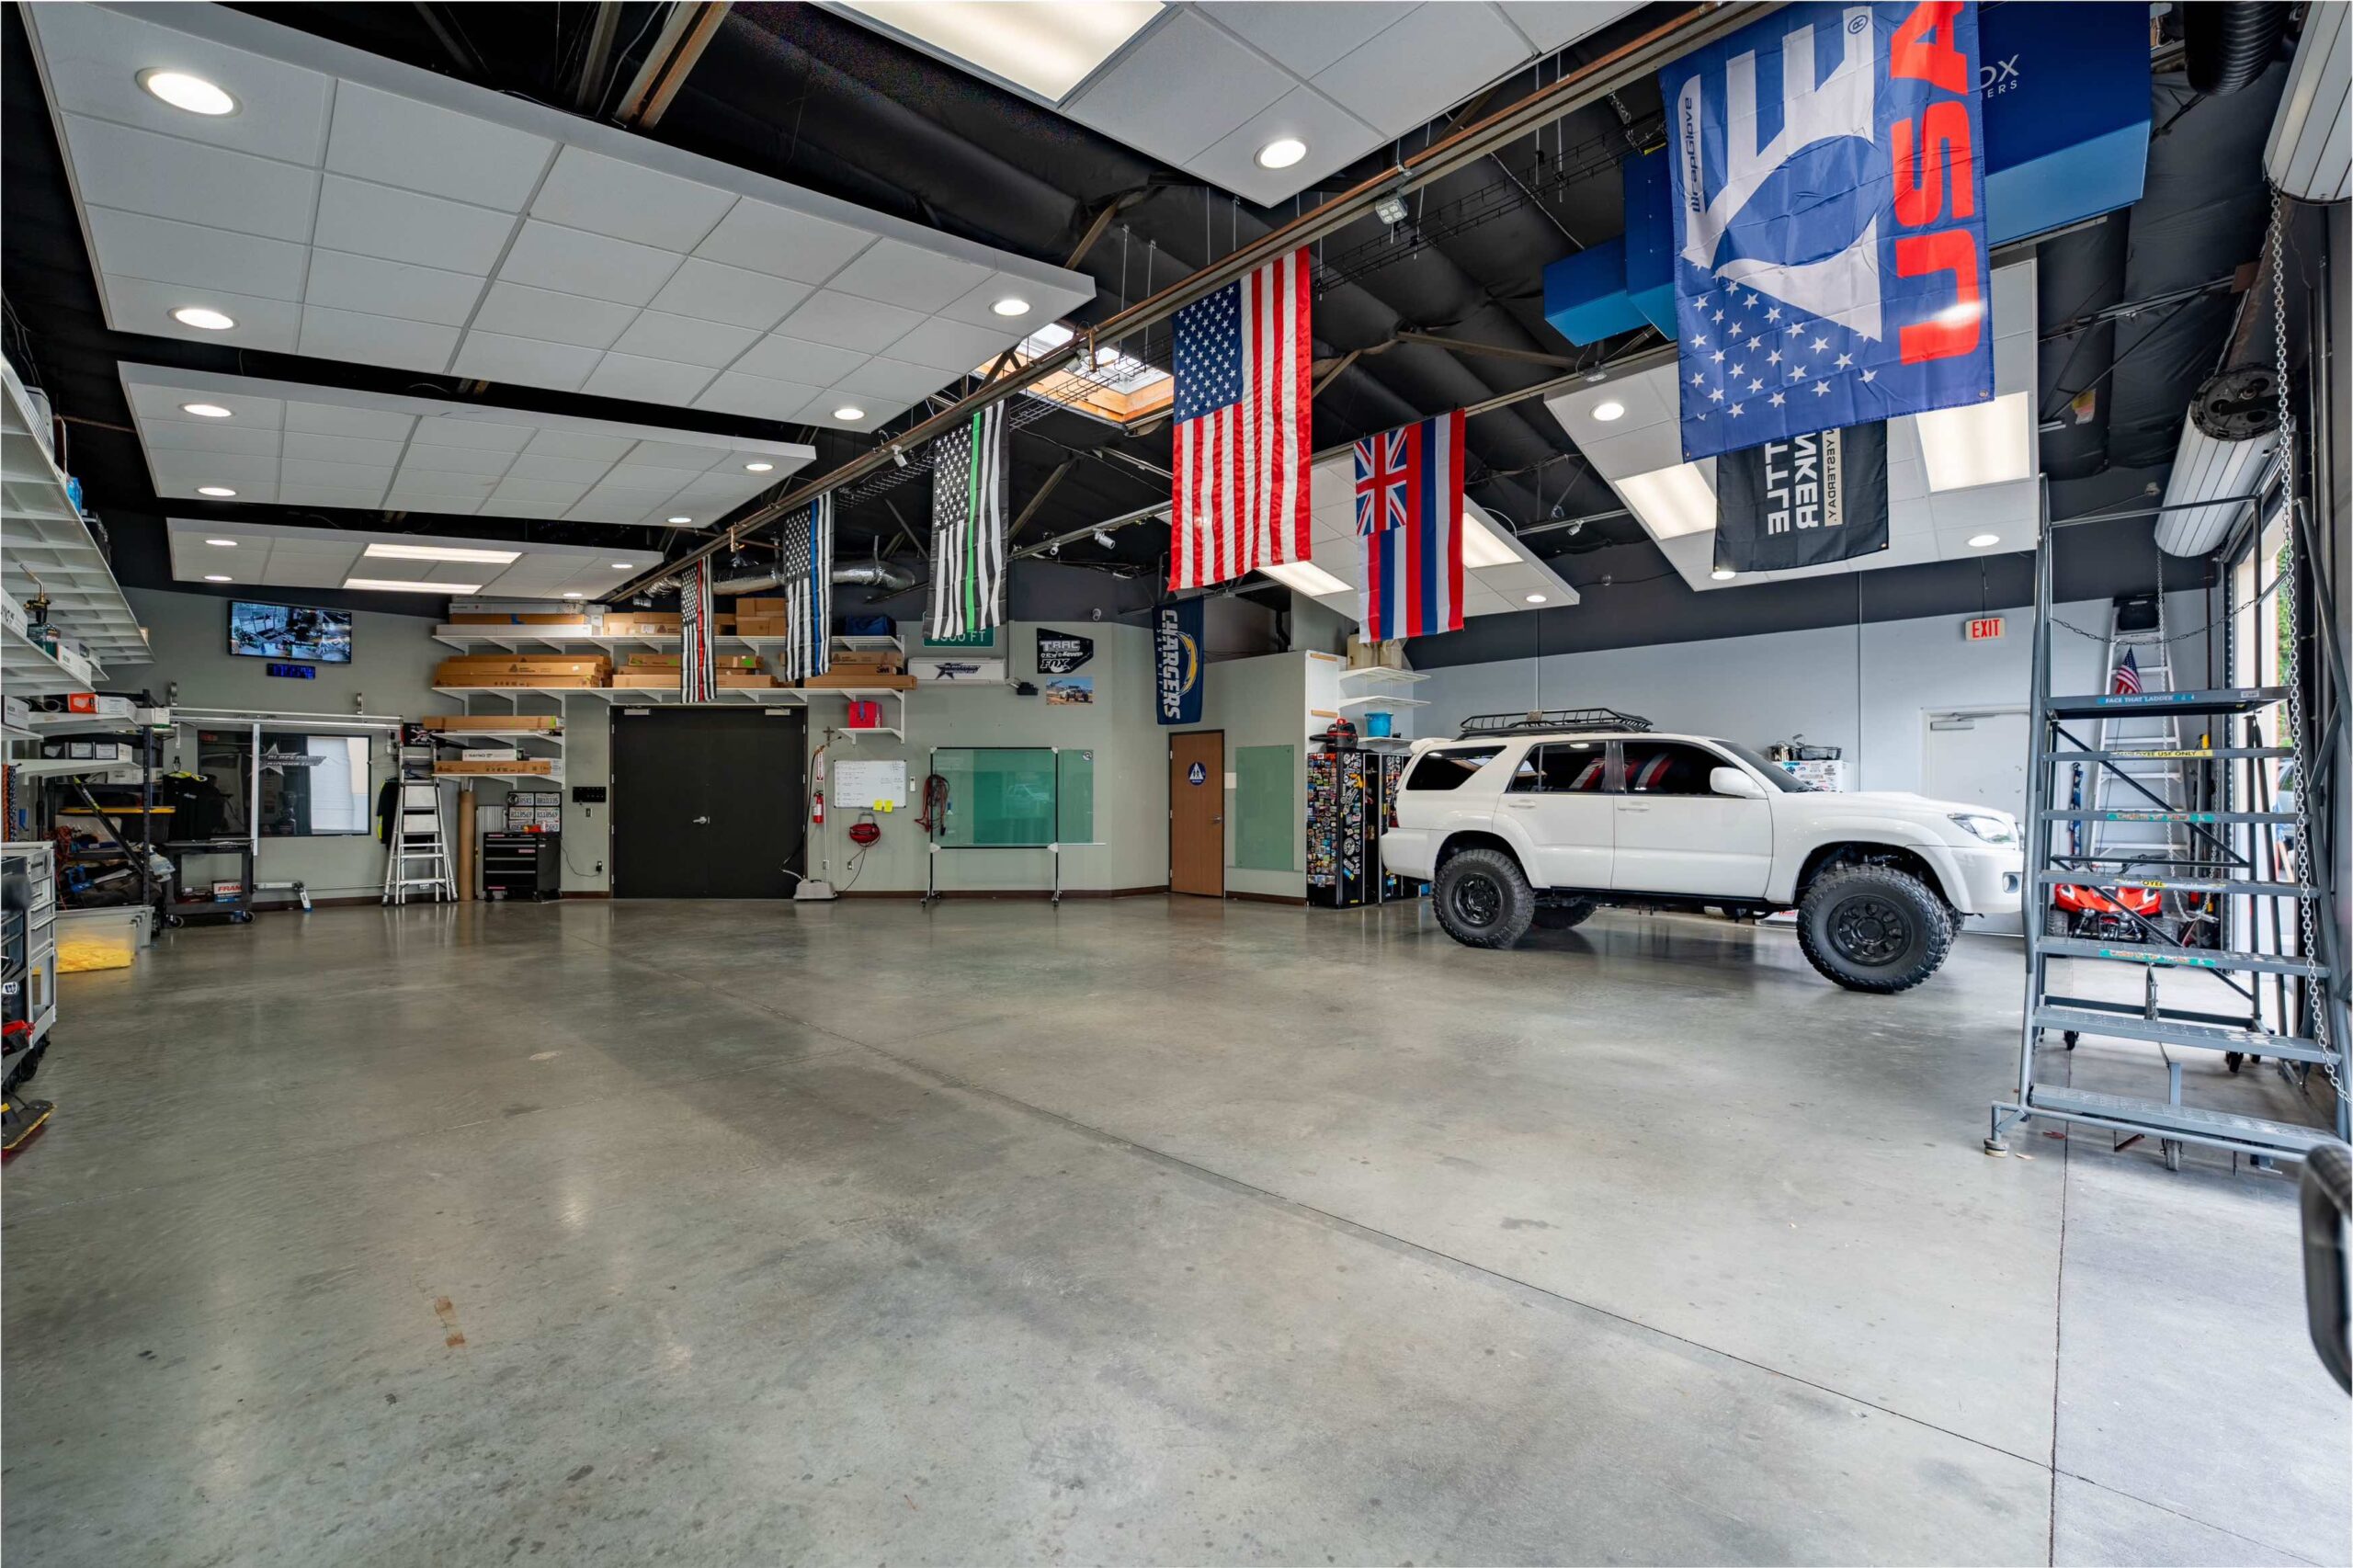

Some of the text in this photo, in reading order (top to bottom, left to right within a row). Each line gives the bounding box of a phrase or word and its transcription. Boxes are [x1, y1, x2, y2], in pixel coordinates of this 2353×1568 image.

[1987, 79, 2018, 98] ERS
[1684, 97, 1700, 212] WrapGlove
[1891, 1, 1980, 365] USA
[971, 631, 986, 642] FT
[1972, 619, 2000, 639] EXIT
[1040, 658, 1071, 670] FOX
[1162, 609, 1181, 720] CHARGERS
